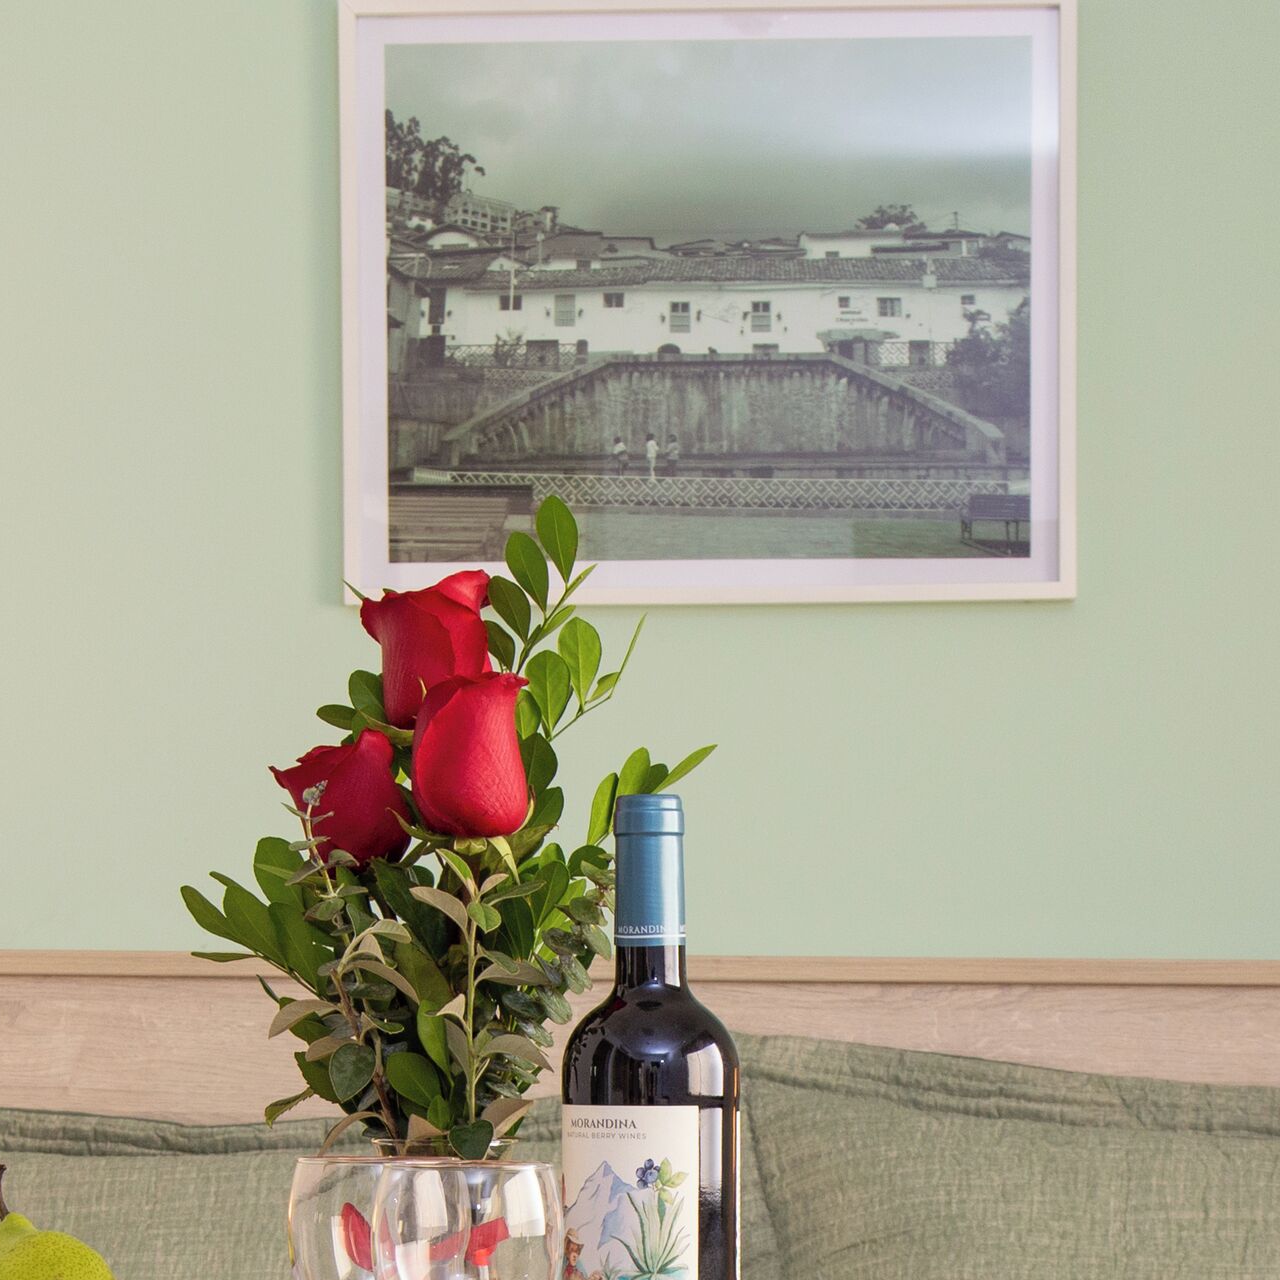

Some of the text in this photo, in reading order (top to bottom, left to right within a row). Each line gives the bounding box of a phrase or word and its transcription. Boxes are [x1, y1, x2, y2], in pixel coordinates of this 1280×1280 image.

[618, 925, 666, 934] MORANDIN
[570, 1118, 637, 1129] MORANDINA
[618, 1132, 647, 1140] WINES
